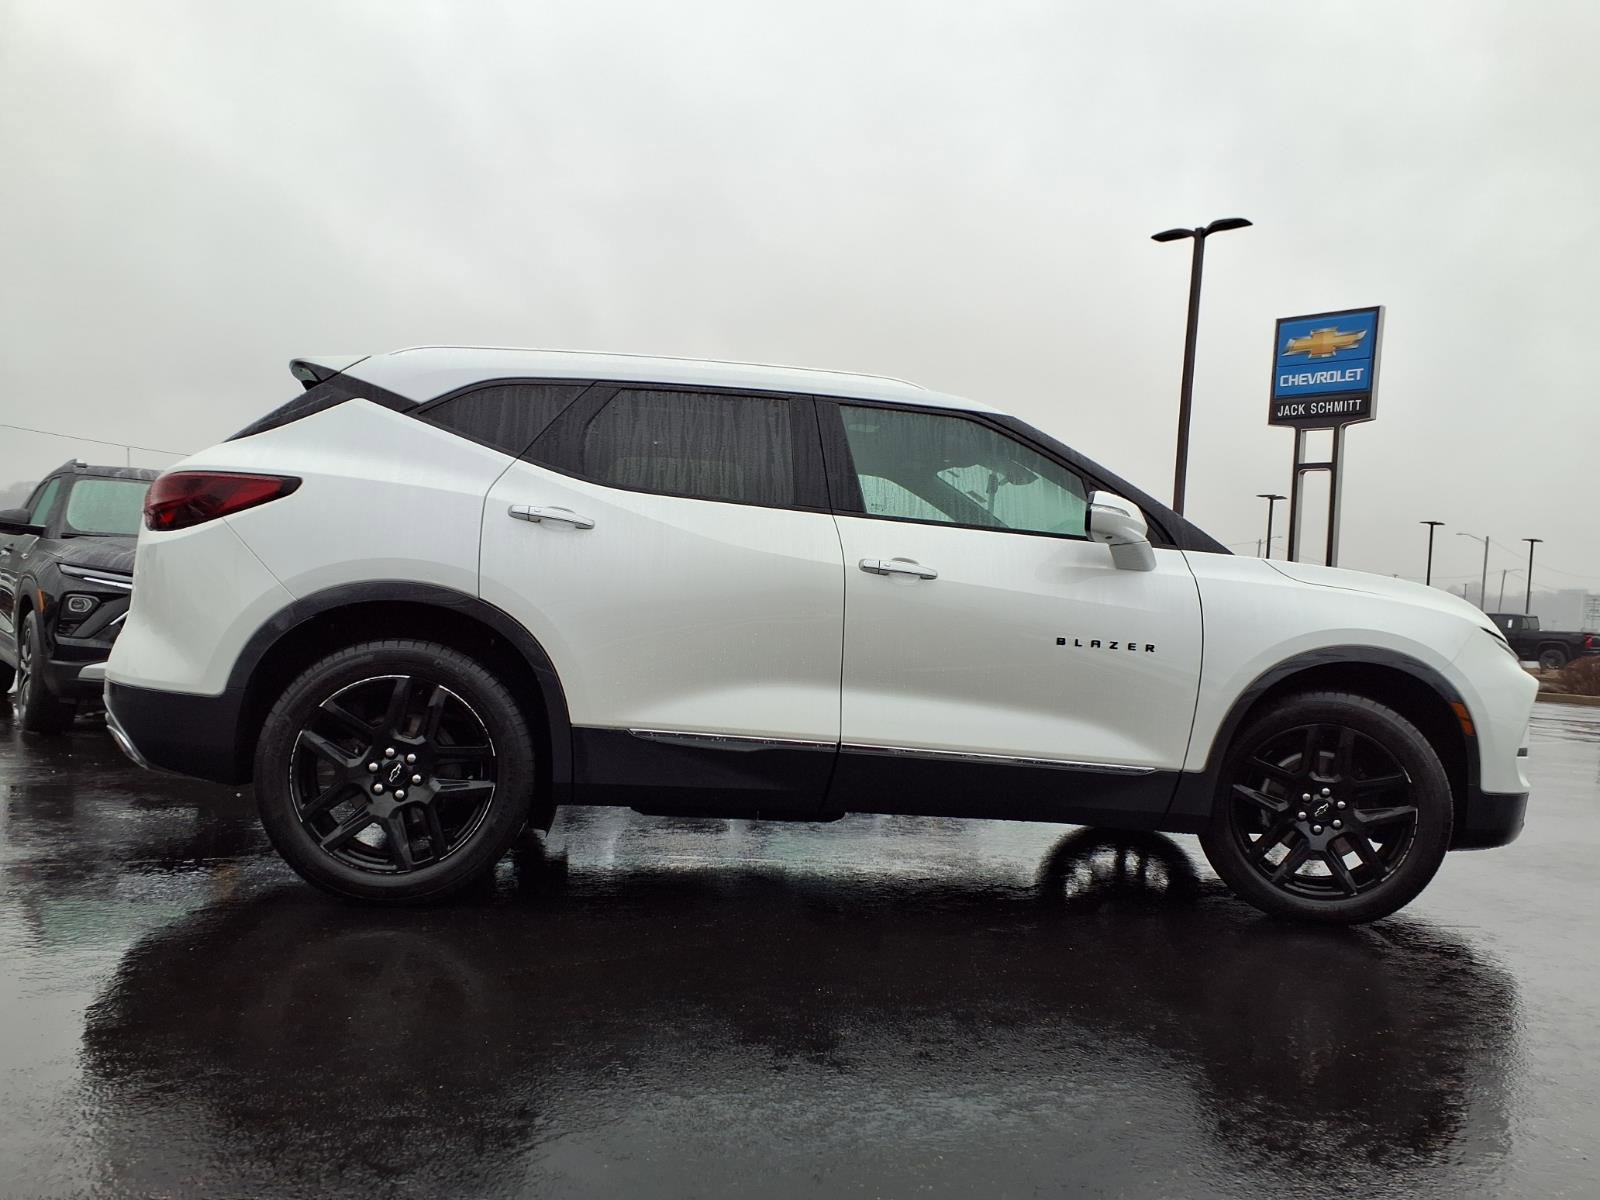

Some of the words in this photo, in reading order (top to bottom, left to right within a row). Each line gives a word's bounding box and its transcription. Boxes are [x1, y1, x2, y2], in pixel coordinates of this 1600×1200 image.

[1280, 368, 1364, 387] CHEVROLET
[1277, 403, 1306, 417] JACK
[1310, 400, 1362, 414] SCHMITT
[1056, 637, 1155, 652] BLAZER
